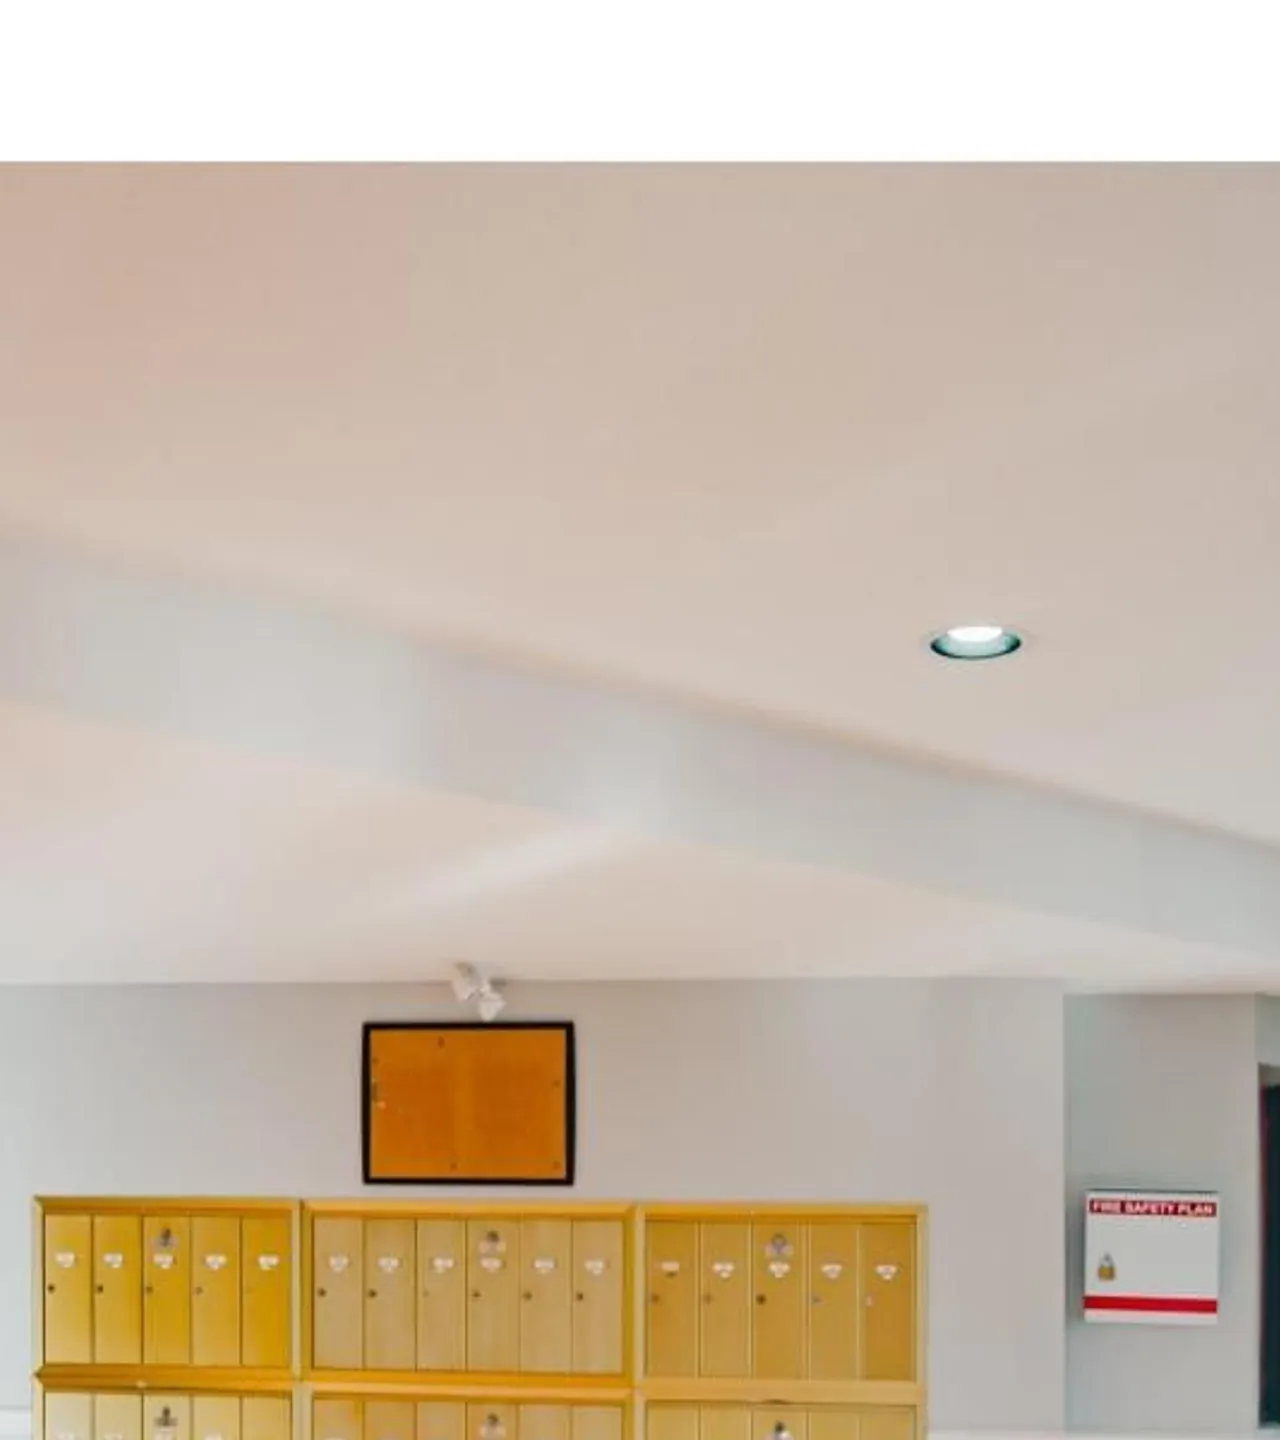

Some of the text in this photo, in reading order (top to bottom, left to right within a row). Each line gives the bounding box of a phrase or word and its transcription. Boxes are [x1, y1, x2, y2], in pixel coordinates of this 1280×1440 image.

[1093, 1200, 1213, 1216] FIRE SAFETY PLAN
